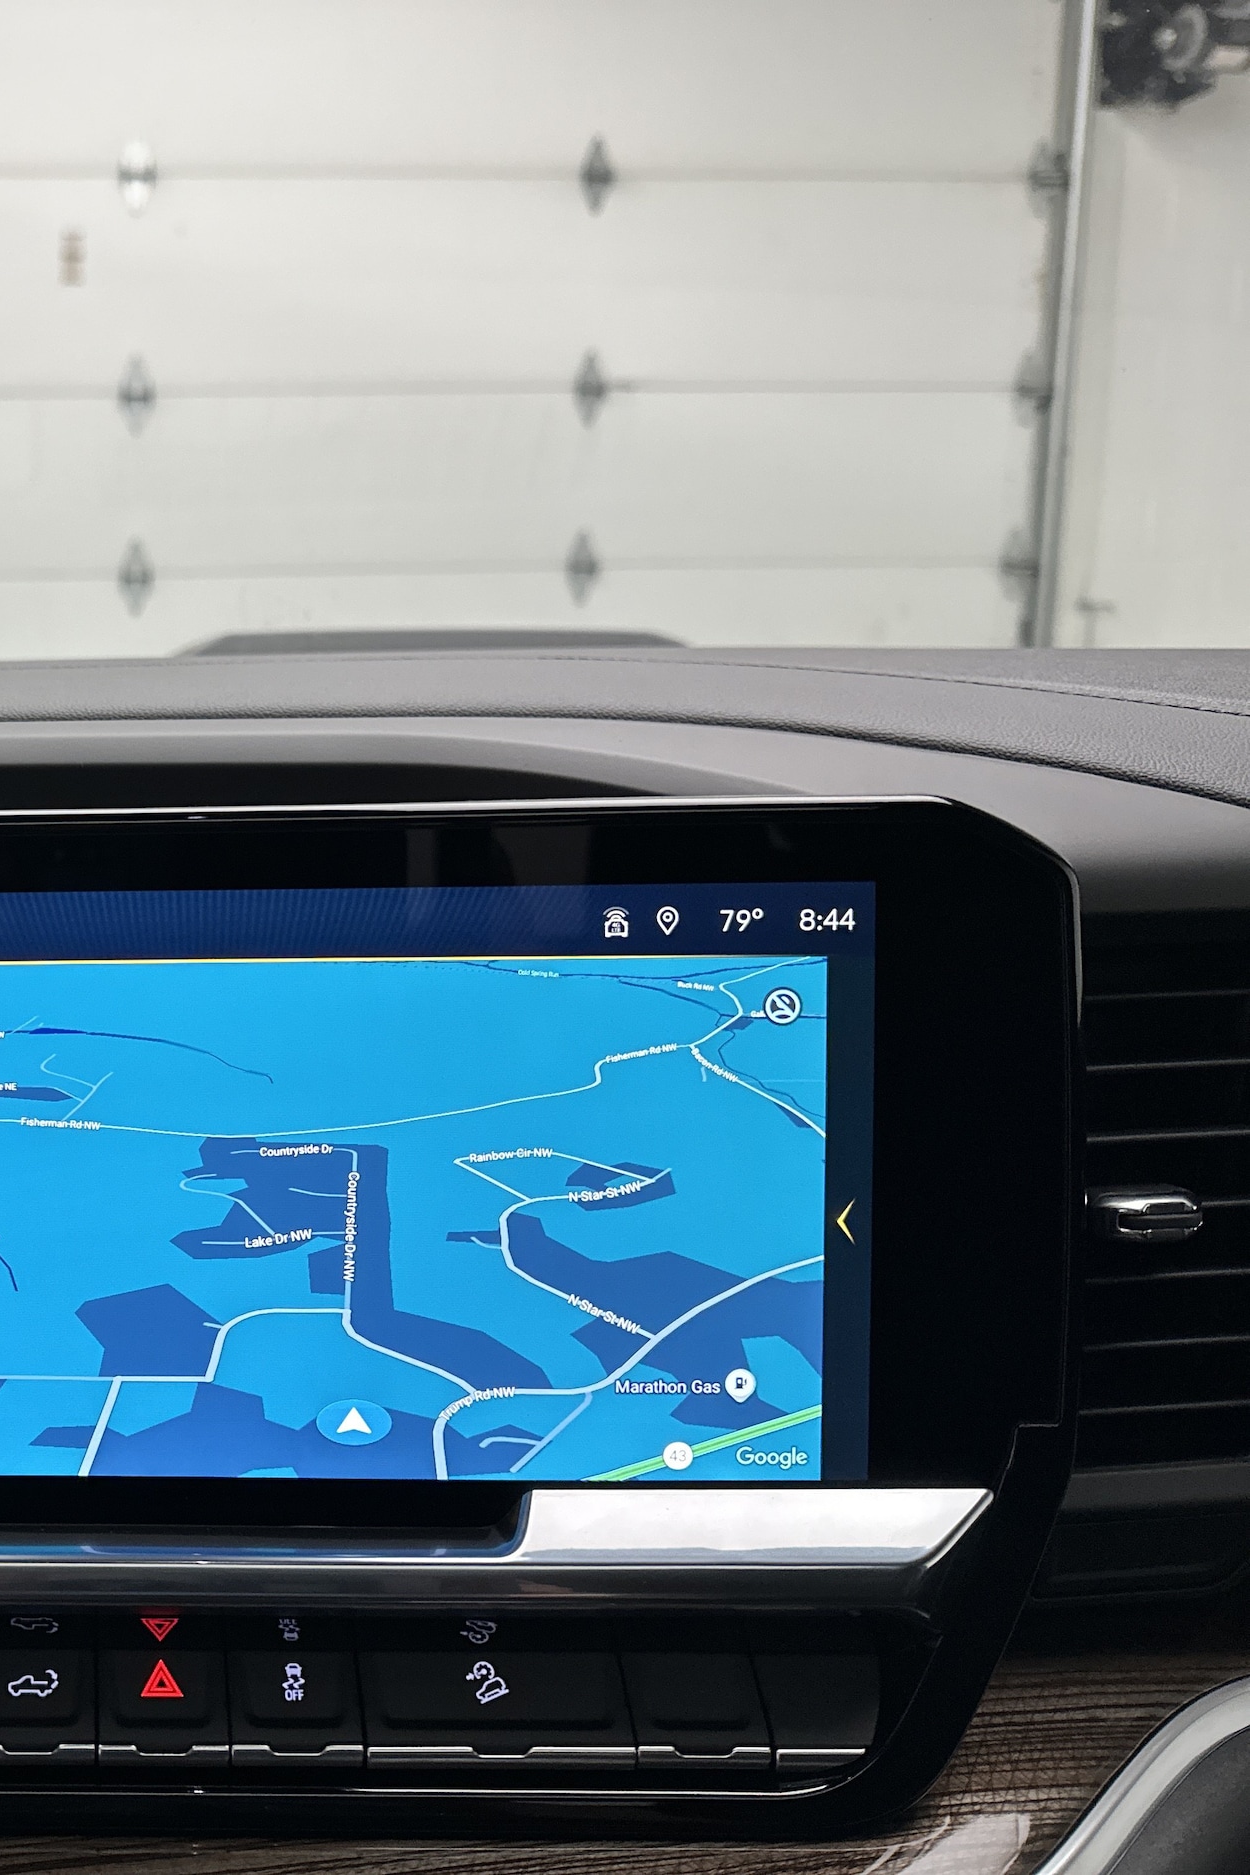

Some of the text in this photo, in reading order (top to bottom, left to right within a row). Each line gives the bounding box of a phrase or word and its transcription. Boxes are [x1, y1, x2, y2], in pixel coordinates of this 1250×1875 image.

[719, 907, 764, 932] 79°
[798, 907, 856, 931] 8:44
[531, 970, 548, 978] Spring
[703, 984, 715, 992] NW
[605, 1043, 678, 1064] Fisherman Rd NW
[691, 1046, 738, 1083] Bacon Rd NW
[4, 1082, 17, 1091] NE
[20, 1116, 101, 1131] Fisherman Rd NW
[259, 1143, 334, 1157] Countryside Dr
[469, 1148, 553, 1163] Rainbow Cir NW
[568, 1181, 642, 1202] N Star St NW
[343, 1171, 361, 1282] Countryside Dr NW
[244, 1228, 312, 1249] Lake Dr NW
[567, 1293, 641, 1335] N Star St NW
[615, 1379, 721, 1394] Marathon Gas
[439, 1386, 516, 1421] Trump Rd NW
[669, 1449, 687, 1462] 43
[735, 1446, 809, 1470] Google
[284, 1689, 304, 1702] OFF
